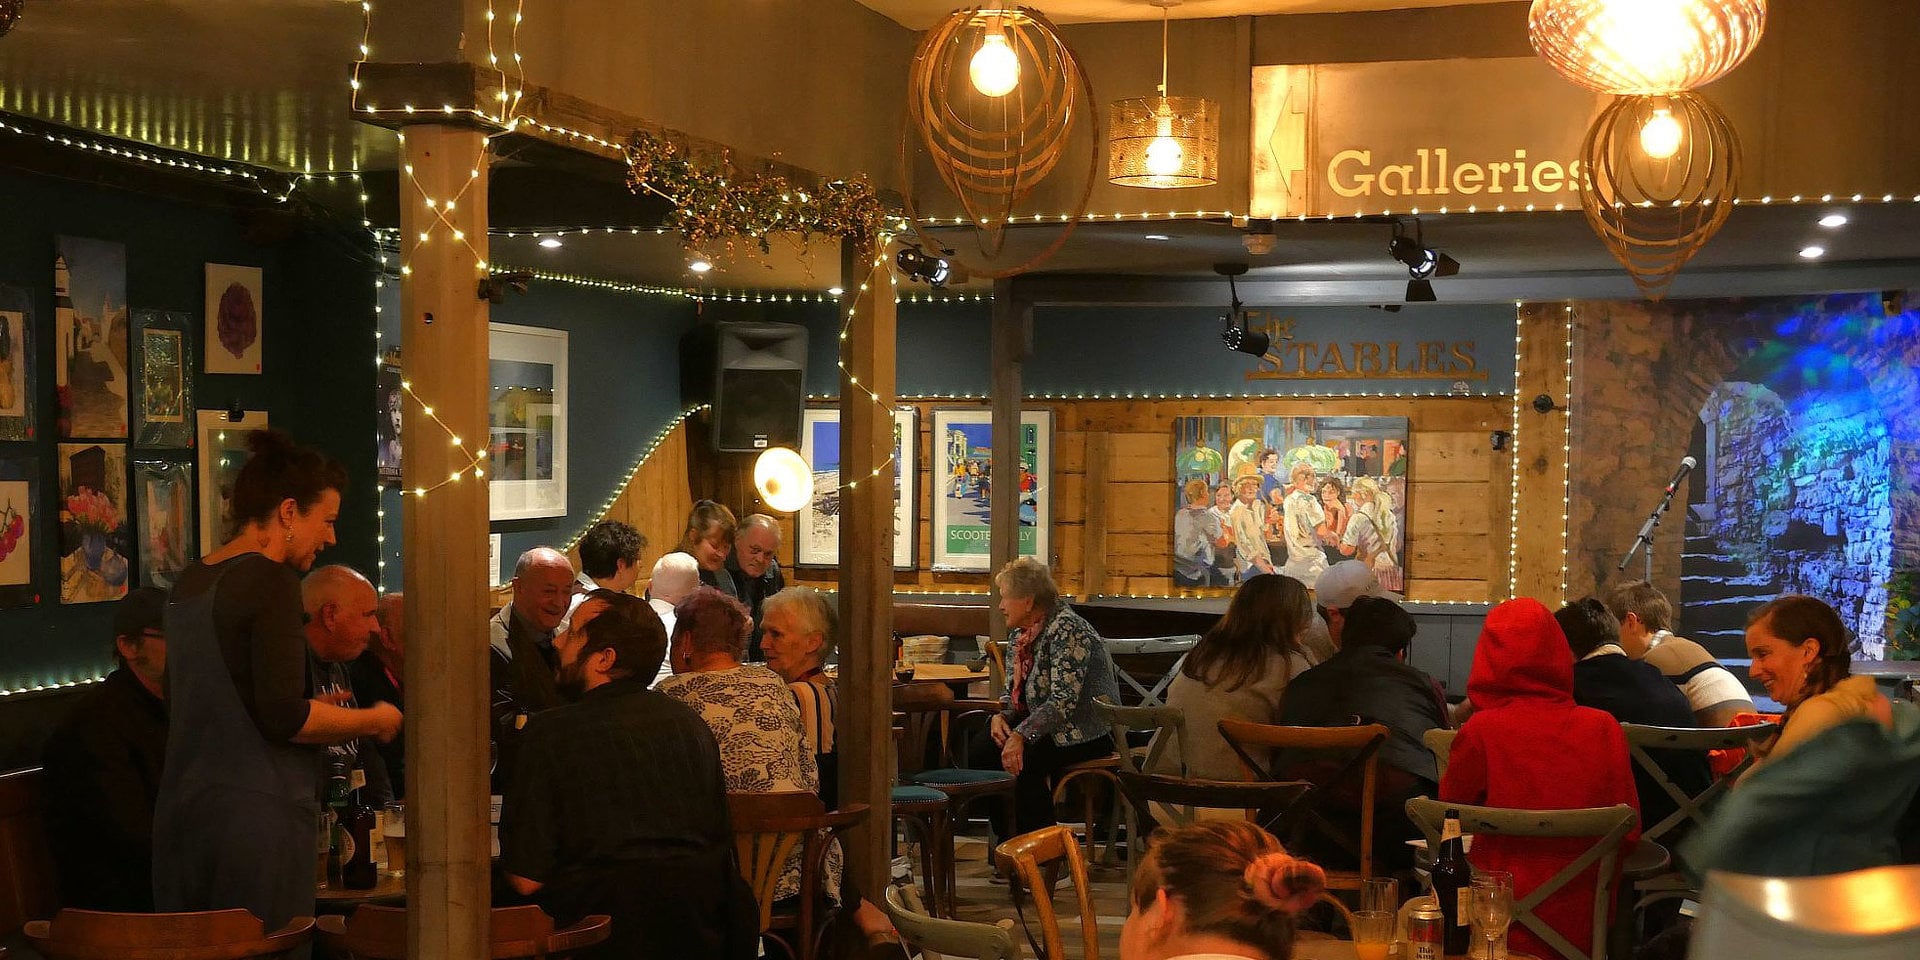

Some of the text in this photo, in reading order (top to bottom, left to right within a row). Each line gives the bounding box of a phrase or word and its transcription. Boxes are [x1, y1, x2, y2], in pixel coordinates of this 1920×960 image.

[1327, 148, 1594, 197] Galleries
[1257, 341, 1477, 374] STABLES
[950, 530, 991, 540] SCOOTE
